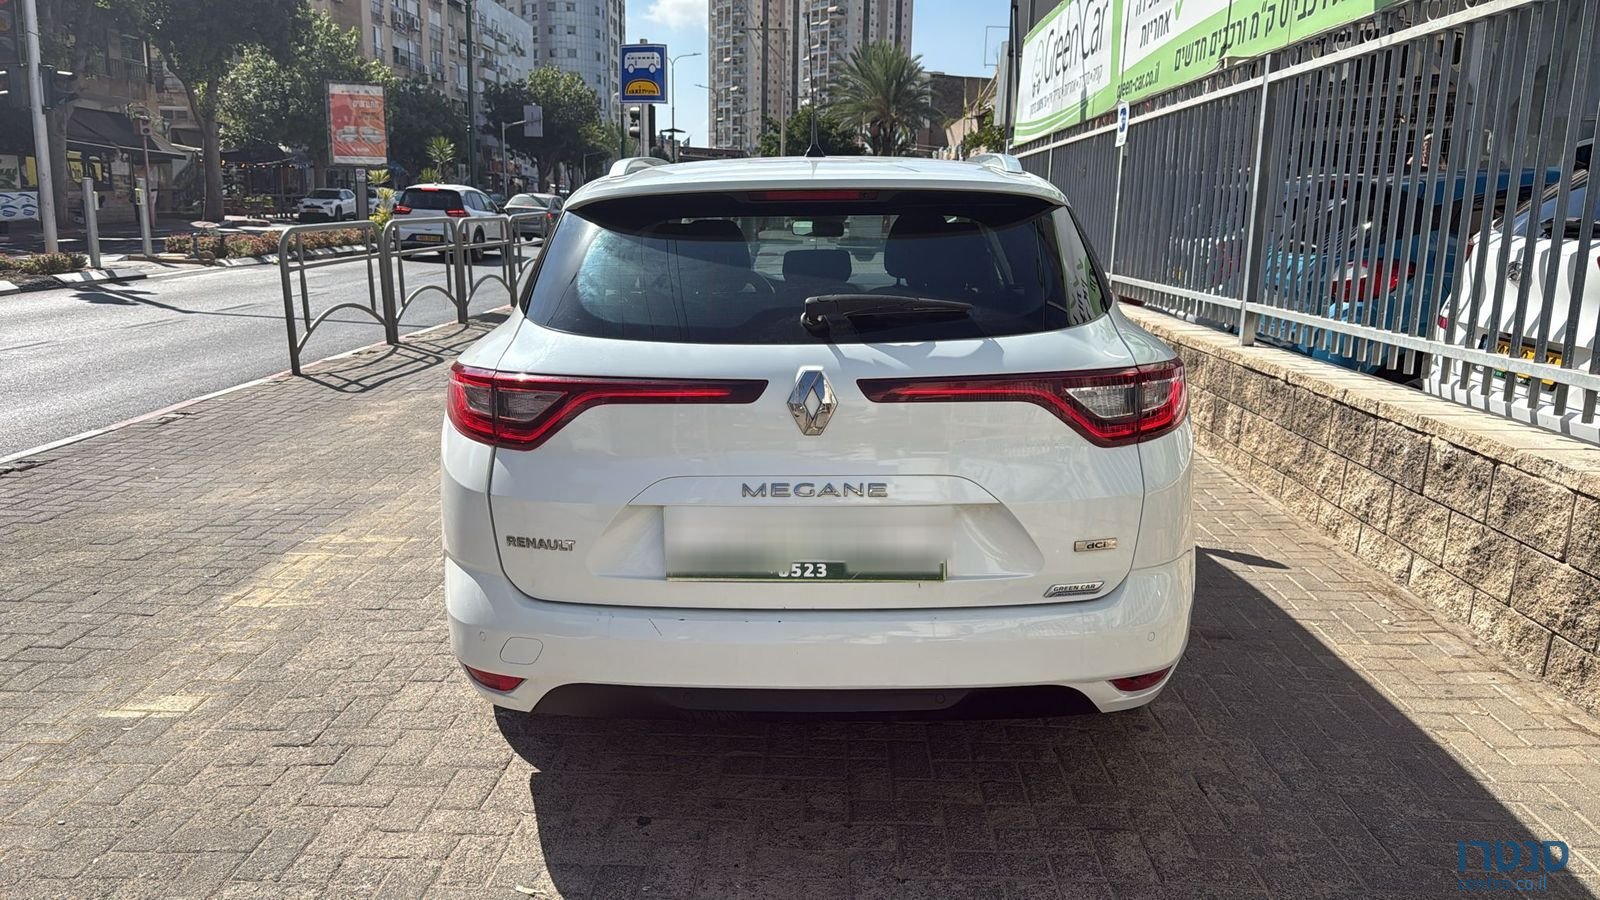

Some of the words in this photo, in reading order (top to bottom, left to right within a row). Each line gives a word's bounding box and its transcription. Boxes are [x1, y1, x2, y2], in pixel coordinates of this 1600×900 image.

[1044, 24, 1079, 84] Green
[1081, 0, 1109, 60] Car
[1140, 8, 1172, 48] אחריות
[1174, 36, 1207, 71] חדשים
[741, 482, 889, 498] MEGANE
[506, 535, 576, 552] RENAULT
